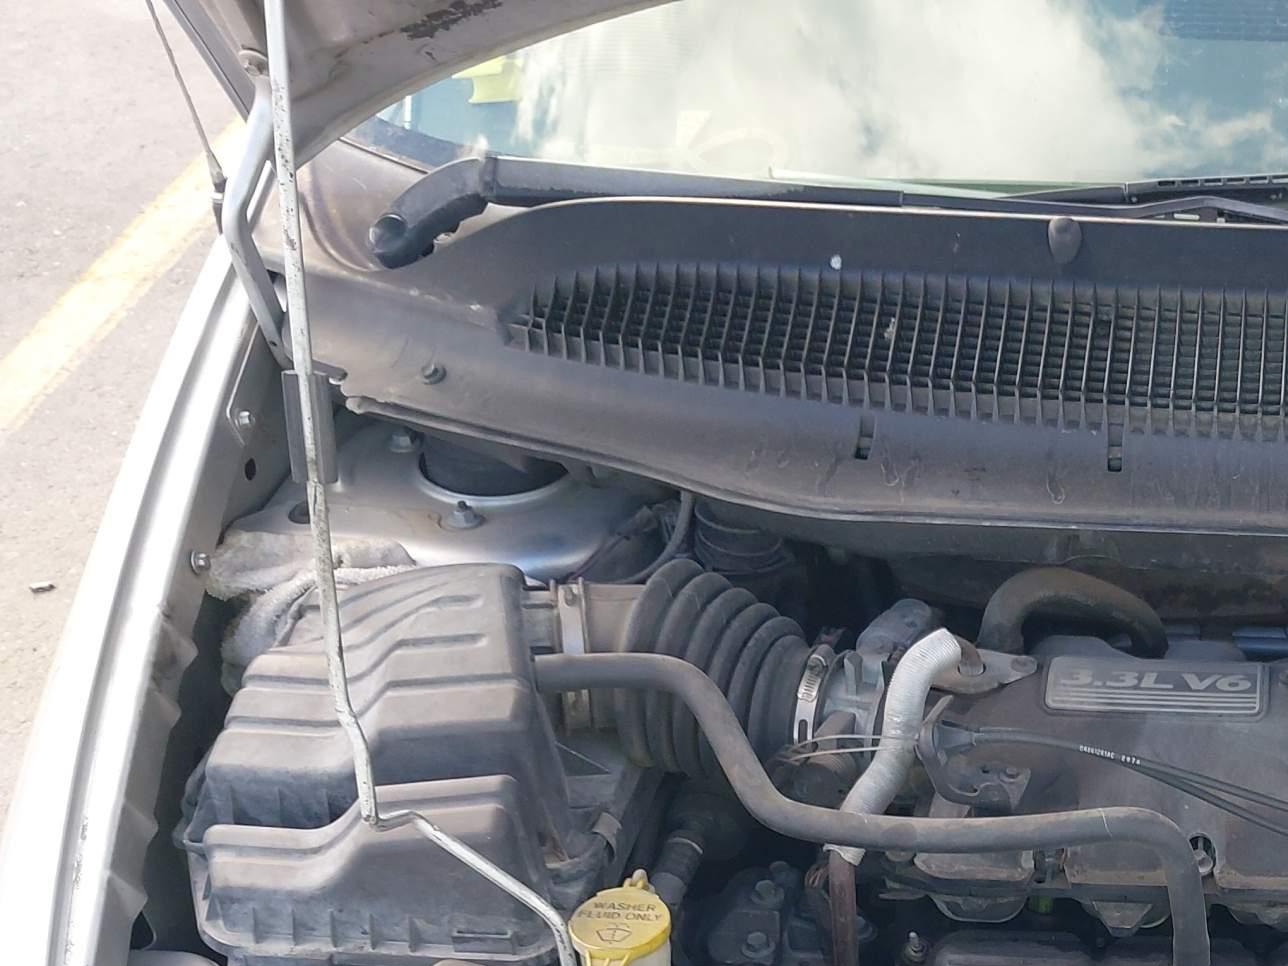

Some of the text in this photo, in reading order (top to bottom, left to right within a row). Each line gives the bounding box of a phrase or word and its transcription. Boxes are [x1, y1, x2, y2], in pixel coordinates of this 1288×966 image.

[1060, 669, 1251, 692] 3.3L V6
[593, 902, 656, 911] WASHER
[578, 910, 662, 921] FLUID ONLY
